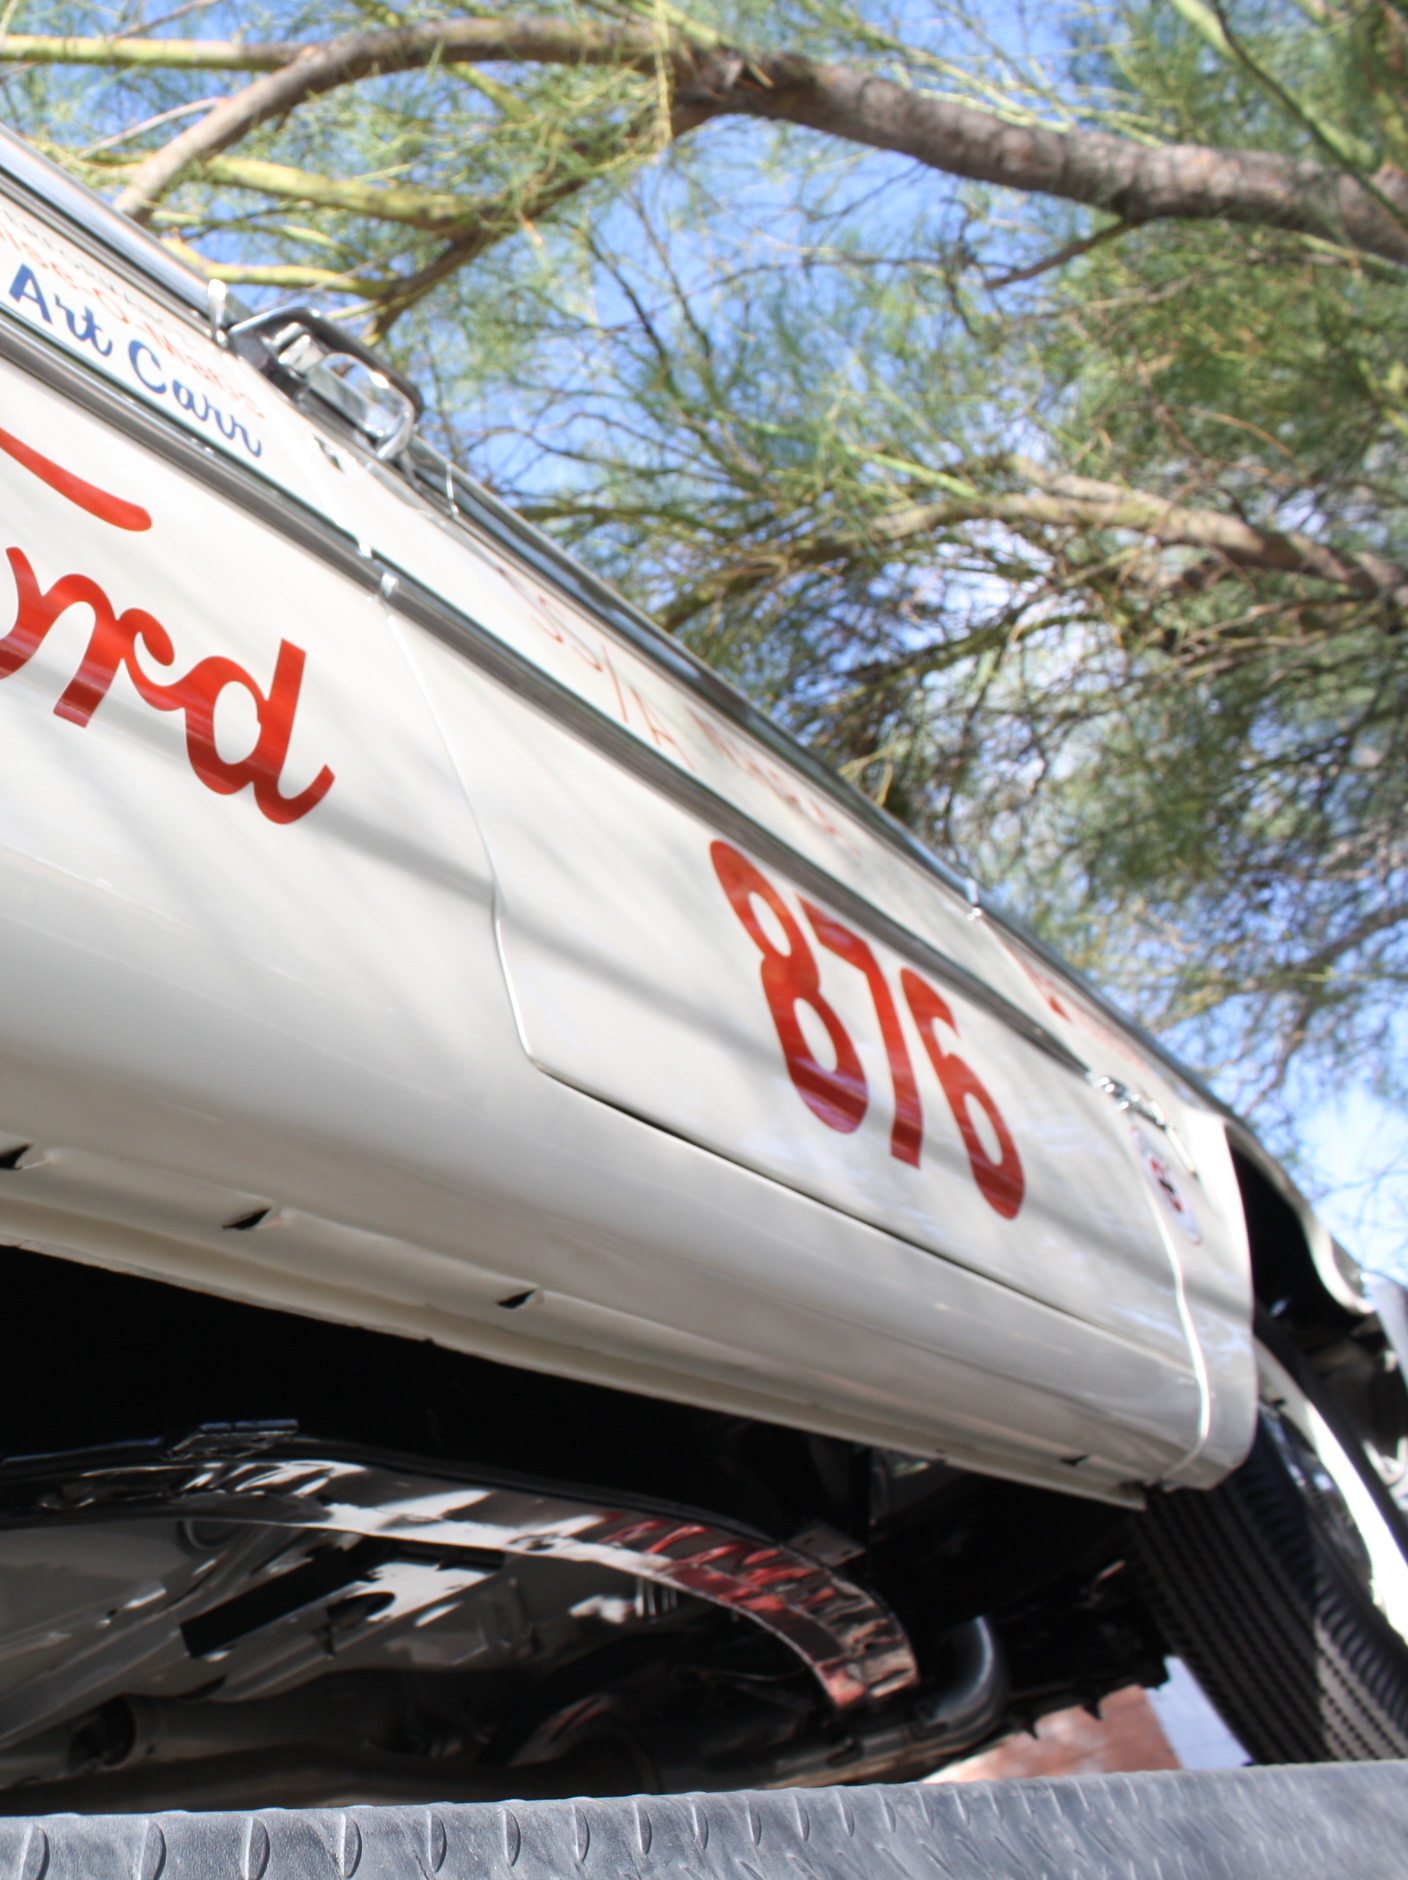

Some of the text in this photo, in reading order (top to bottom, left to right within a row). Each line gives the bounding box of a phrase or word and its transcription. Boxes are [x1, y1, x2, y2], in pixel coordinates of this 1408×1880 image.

[8, 263, 263, 458] Art Carr
[709, 840, 1025, 1220] 876
